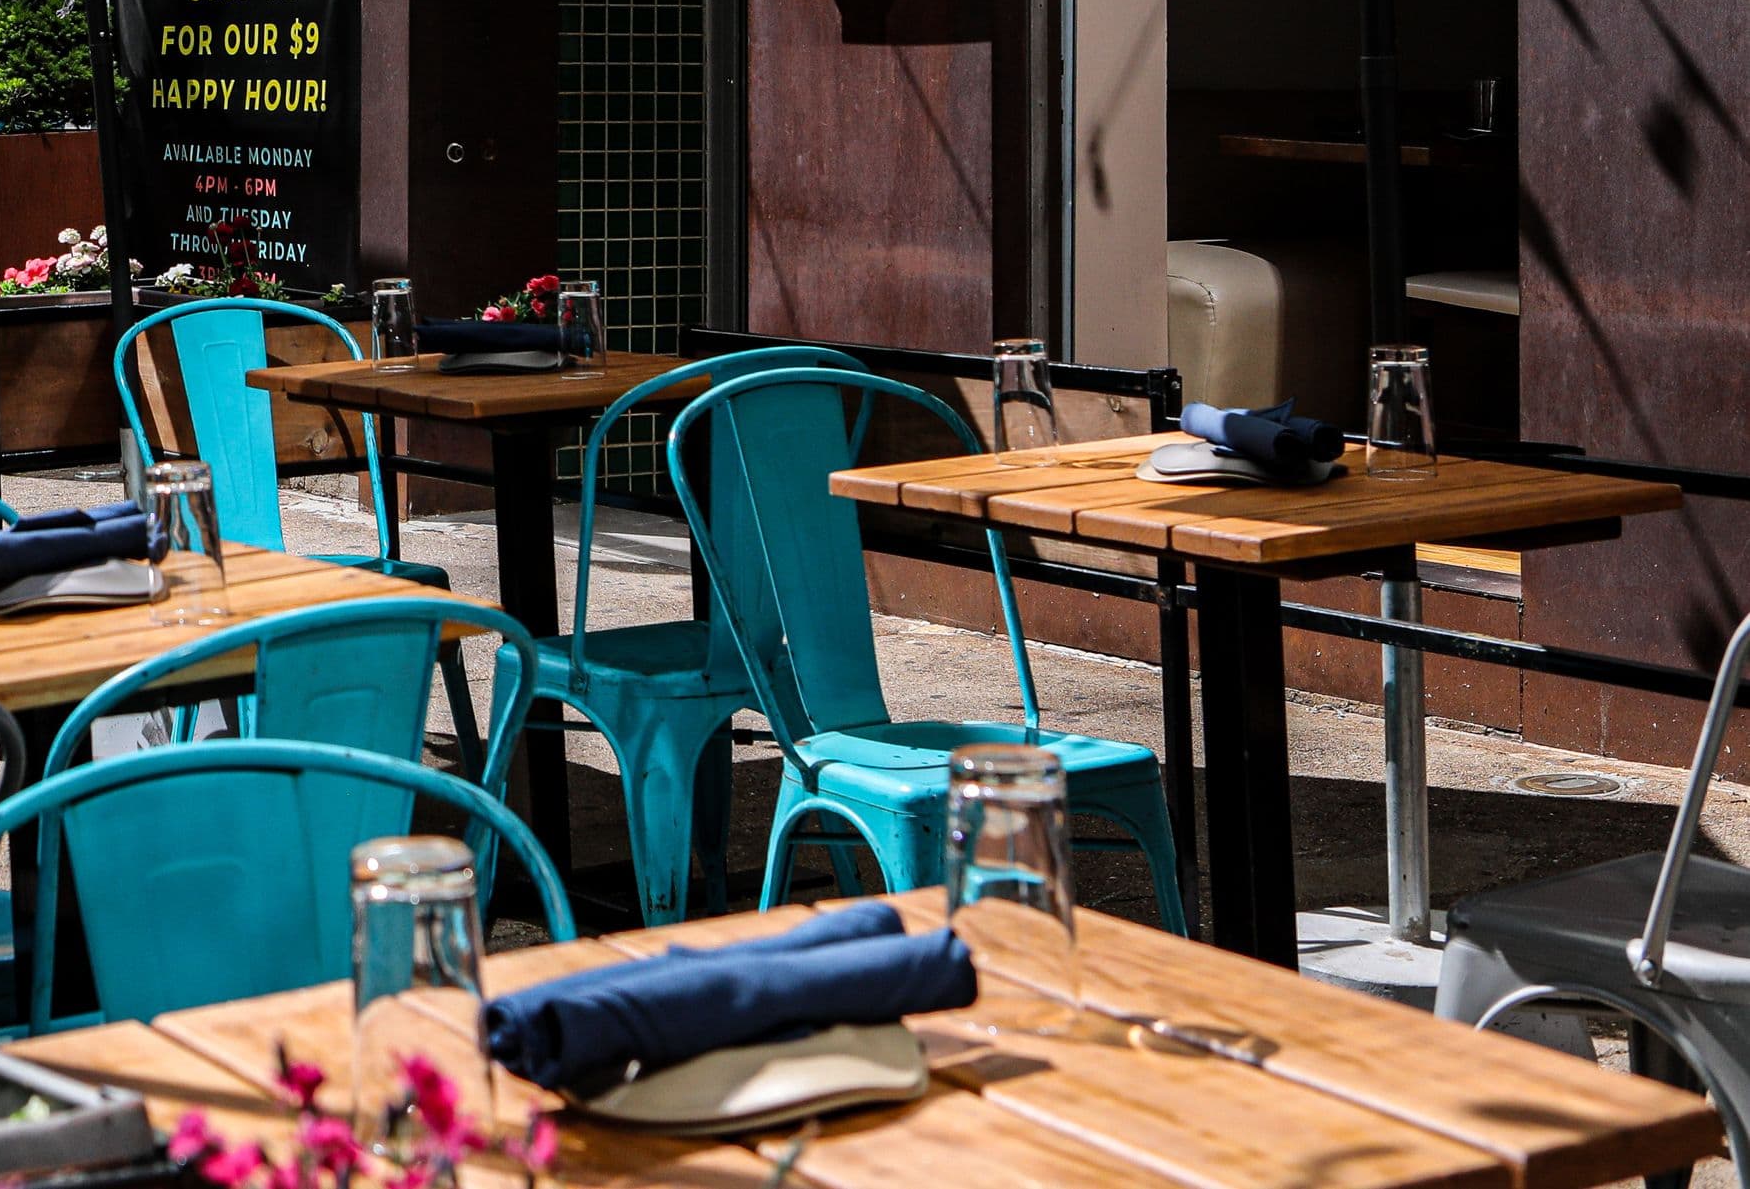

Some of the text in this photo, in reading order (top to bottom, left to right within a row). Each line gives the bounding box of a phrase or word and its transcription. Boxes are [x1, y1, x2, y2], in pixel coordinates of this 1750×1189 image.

[161, 17, 320, 60] FOR OUR $9
[152, 78, 327, 112] HAPPY HOUR!
[163, 143, 313, 168] AVAILABLE MONDAY
[195, 175, 228, 194] 4PM
[244, 178, 277, 197] 6PM
[186, 204, 212, 223] AND
[170, 233, 307, 263] THROU RIDAY
